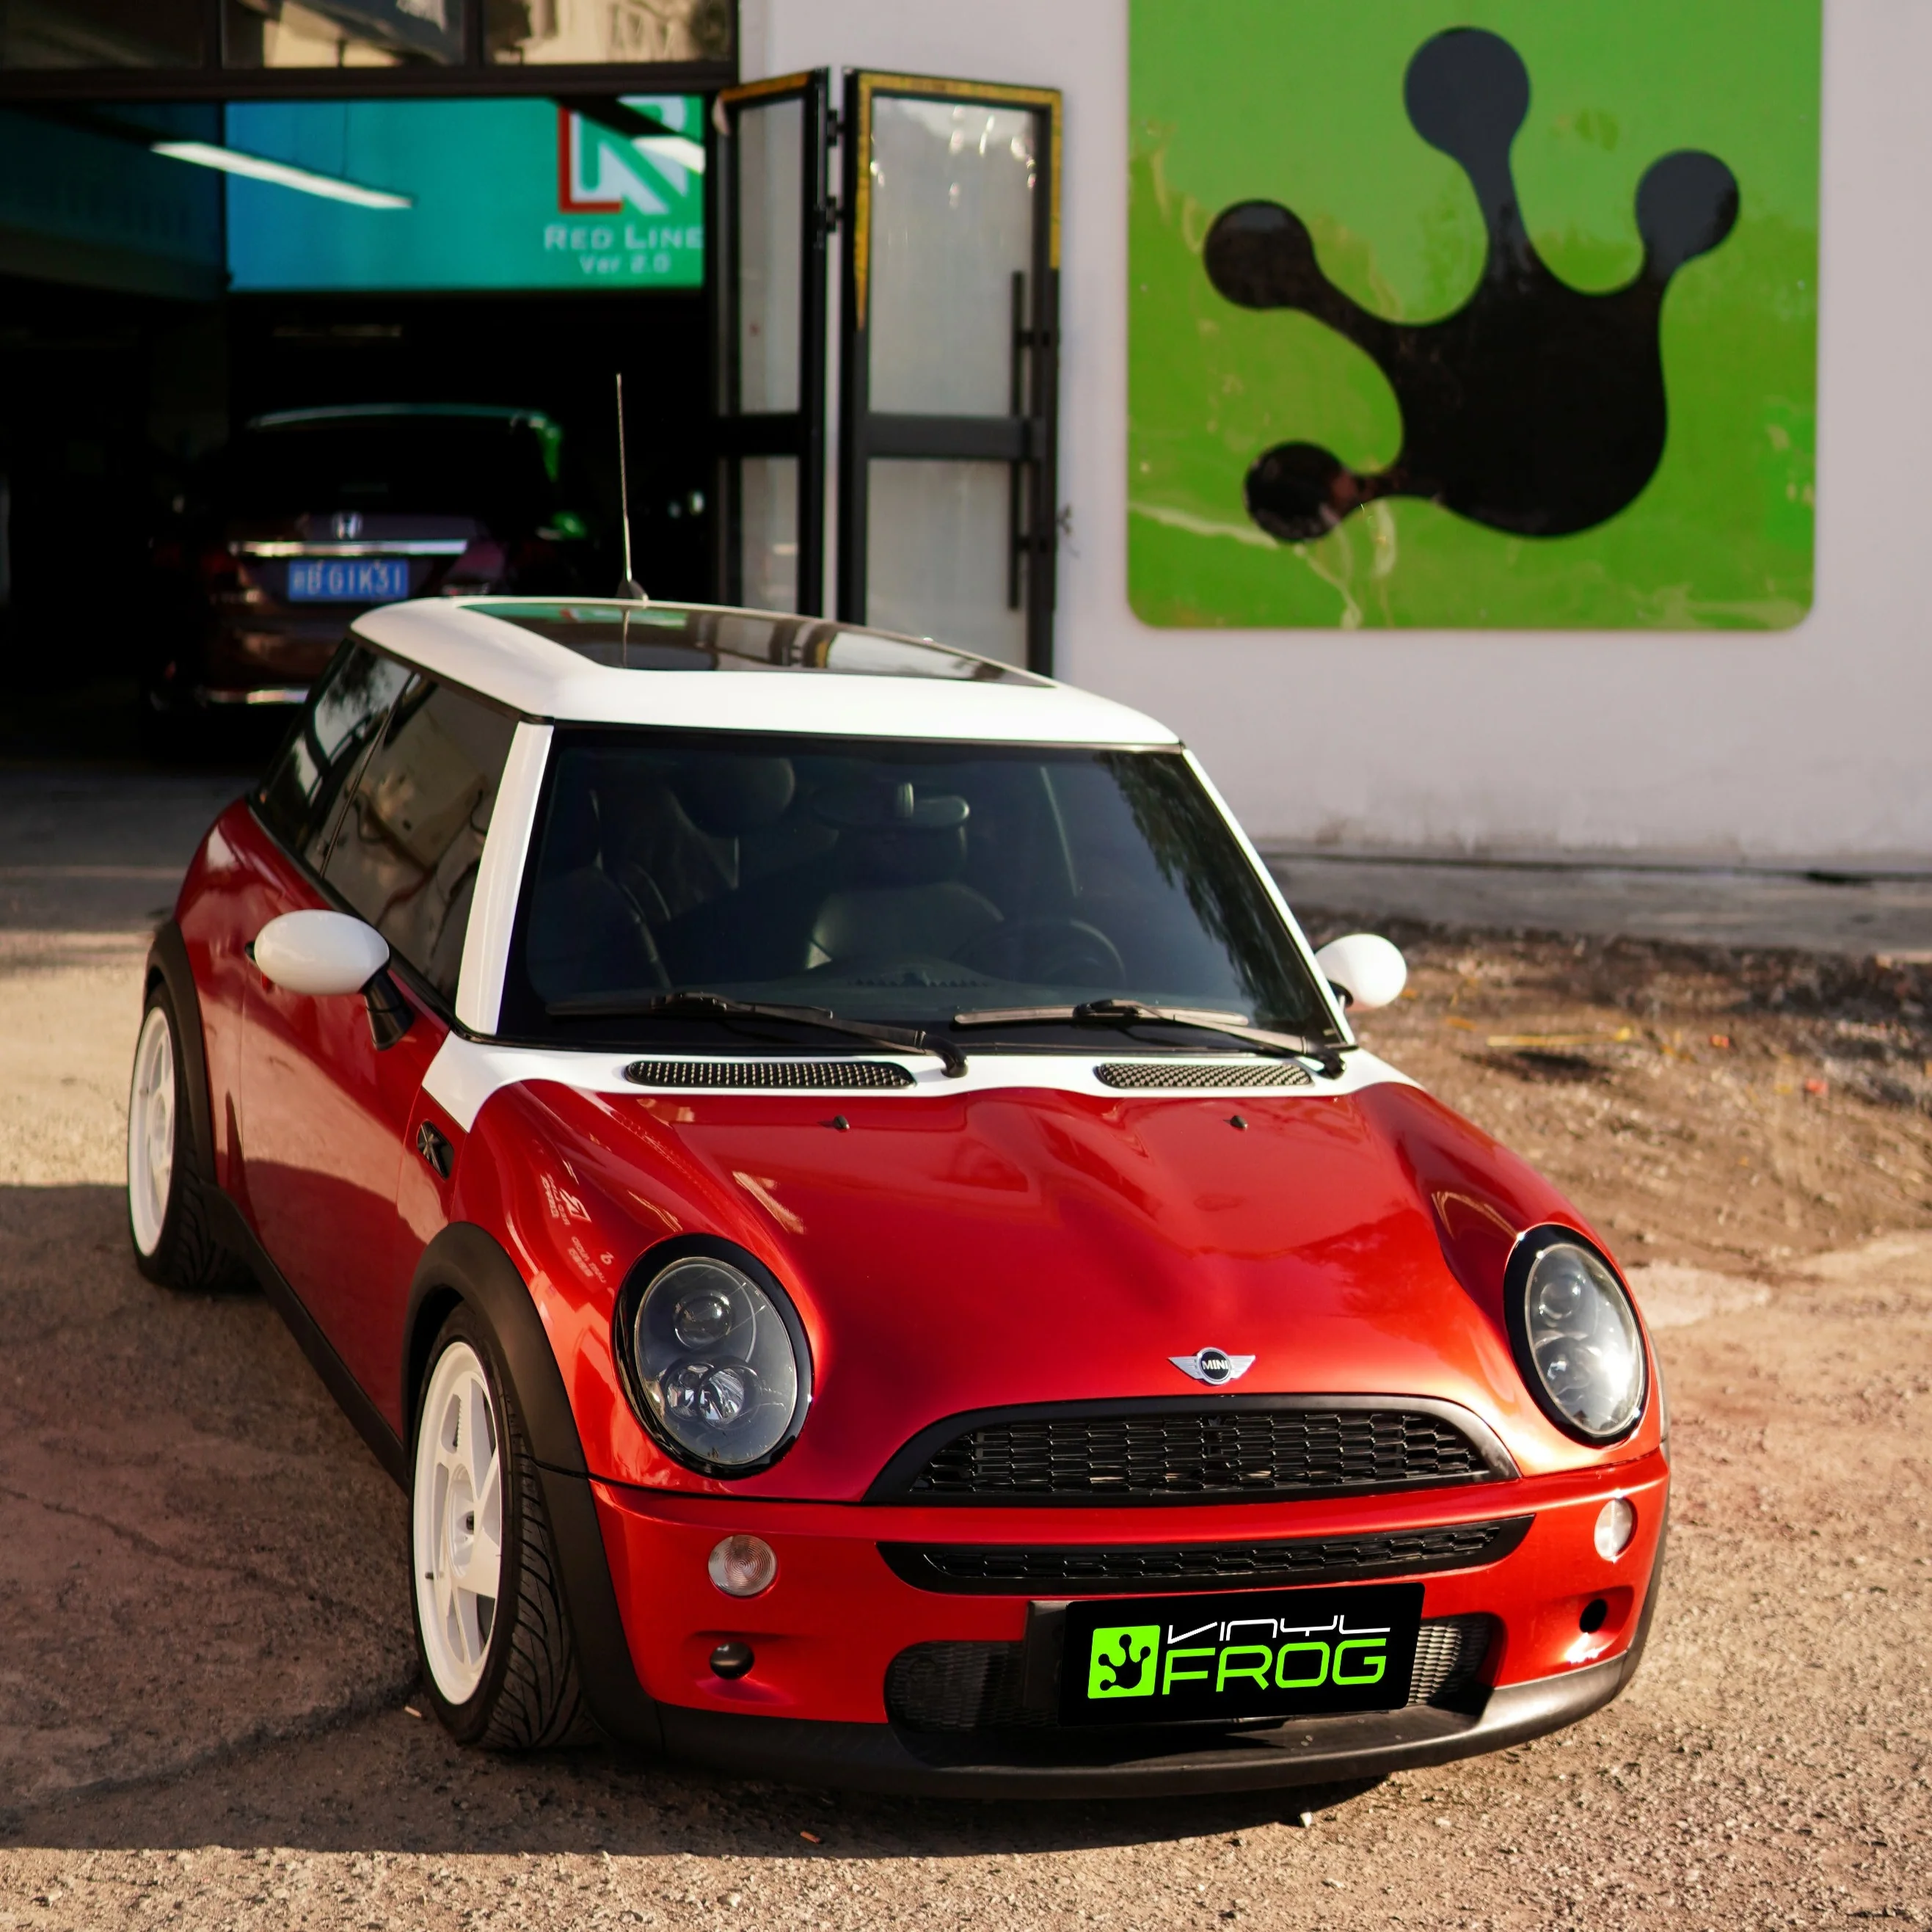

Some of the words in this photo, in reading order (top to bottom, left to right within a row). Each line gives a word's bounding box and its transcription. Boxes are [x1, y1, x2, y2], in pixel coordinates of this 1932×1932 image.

[544, 223, 613, 251] RED
[625, 222, 704, 250] LINE
[1201, 1359, 1230, 1370] MINI
[1167, 1615, 1391, 1644] VINYL
[1162, 1638, 1387, 1696] FROG
